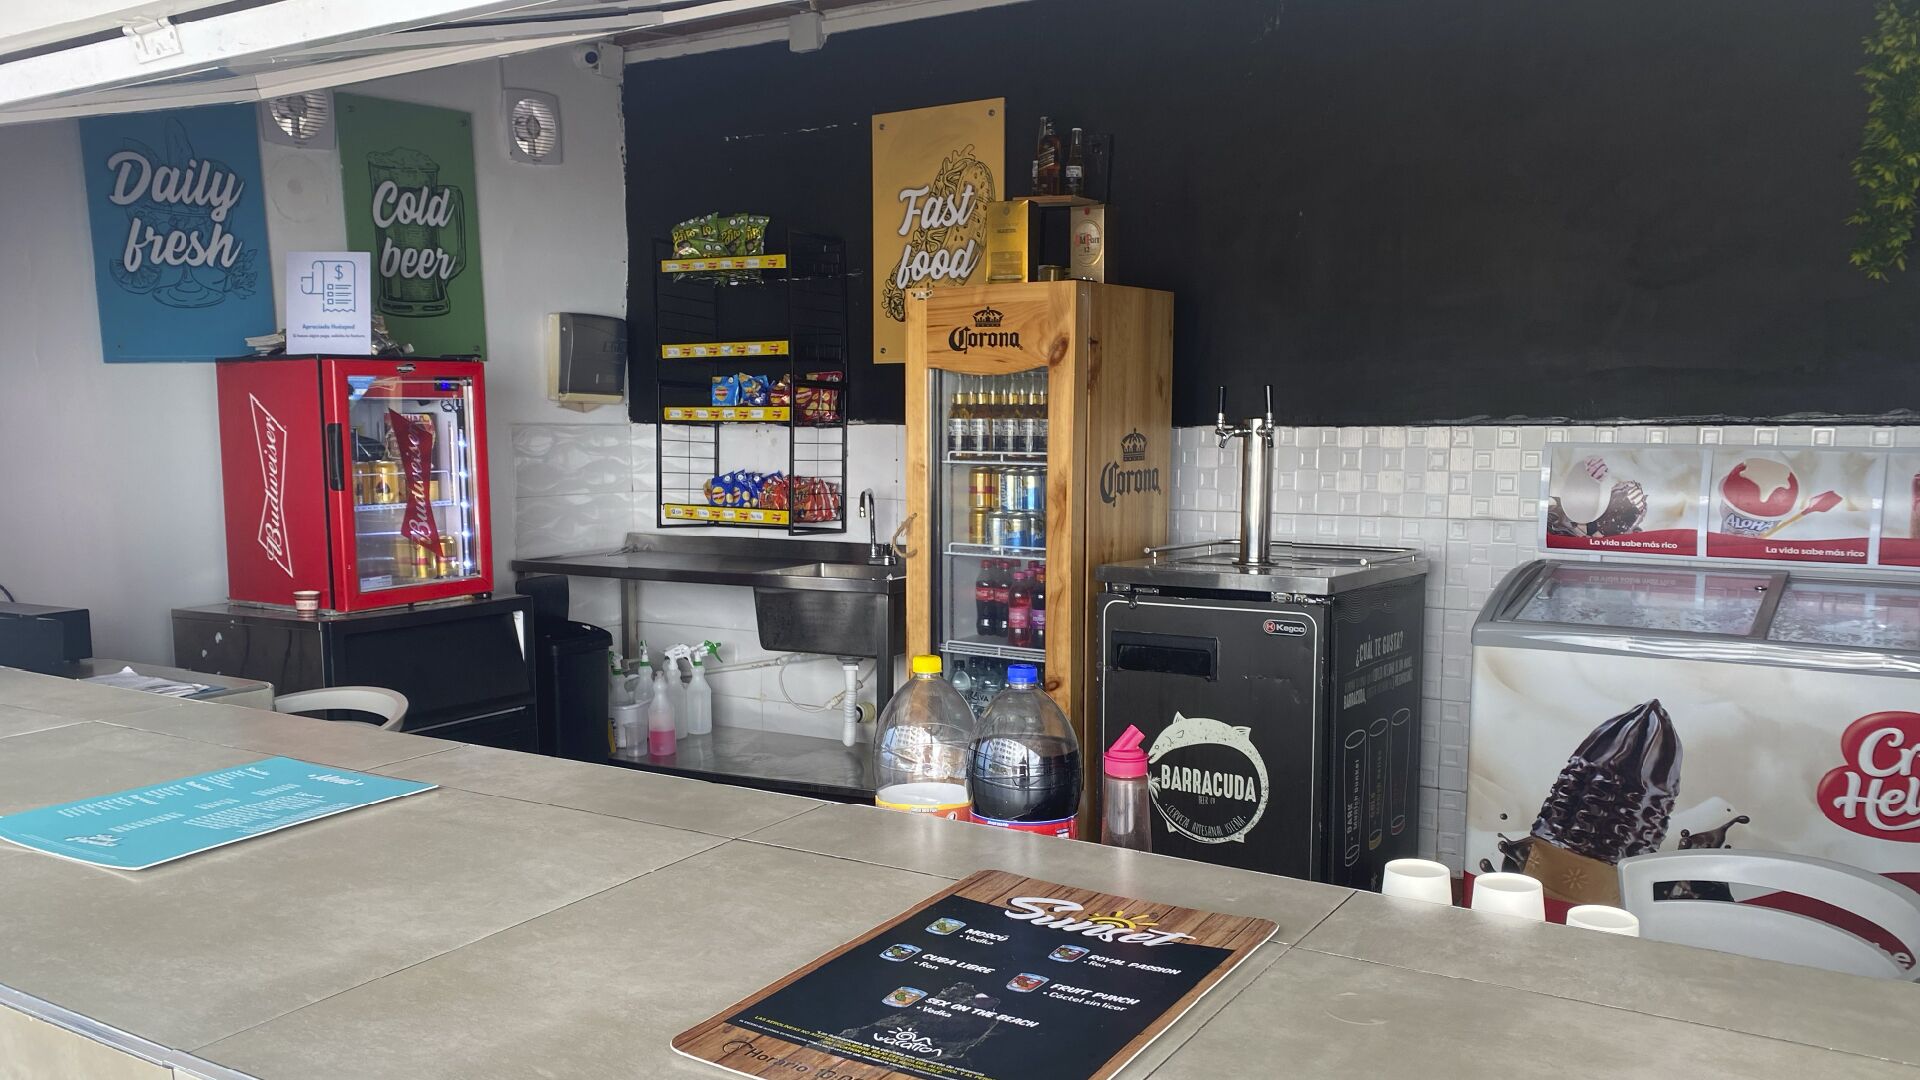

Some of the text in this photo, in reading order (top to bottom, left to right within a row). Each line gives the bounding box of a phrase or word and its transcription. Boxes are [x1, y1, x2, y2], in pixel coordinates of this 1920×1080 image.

[107, 151, 244, 222] Daily
[372, 180, 455, 228] Cold
[898, 184, 978, 236] Fast
[123, 218, 243, 272] fresh
[379, 237, 457, 280] beer
[896, 240, 978, 289] food
[948, 326, 1021, 354] Corona
[266, 415, 282, 561] Budweiser
[408, 424, 432, 545] Budweiser
[1100, 461, 1160, 507] Corona
[1590, 538, 1678, 550] La vida sabe más rico
[1766, 546, 1866, 558] La vida sabe más rico
[1276, 624, 1305, 633] Kegco
[1161, 764, 1256, 802] BARRACUDA
[1166, 804, 1190, 828] CERVEZA
[1192, 822, 1223, 837] ARTESANAL
[1005, 896, 1196, 946] Sunset
[966, 934, 994, 946] Vodka
[918, 961, 939, 970] Ron
[921, 953, 996, 974] CUBA LIBRE
[1088, 954, 1181, 976] ROYAL PASSION
[1049, 991, 1084, 1004] Cóctel
[1084, 998, 1101, 1006] sin
[1050, 983, 1140, 1005] FRUIT PUNCH
[922, 1006, 952, 1018] Vodka
[924, 998, 1040, 1028] SEX ON THE BEACH
[744, 1048, 808, 1072] Horario
